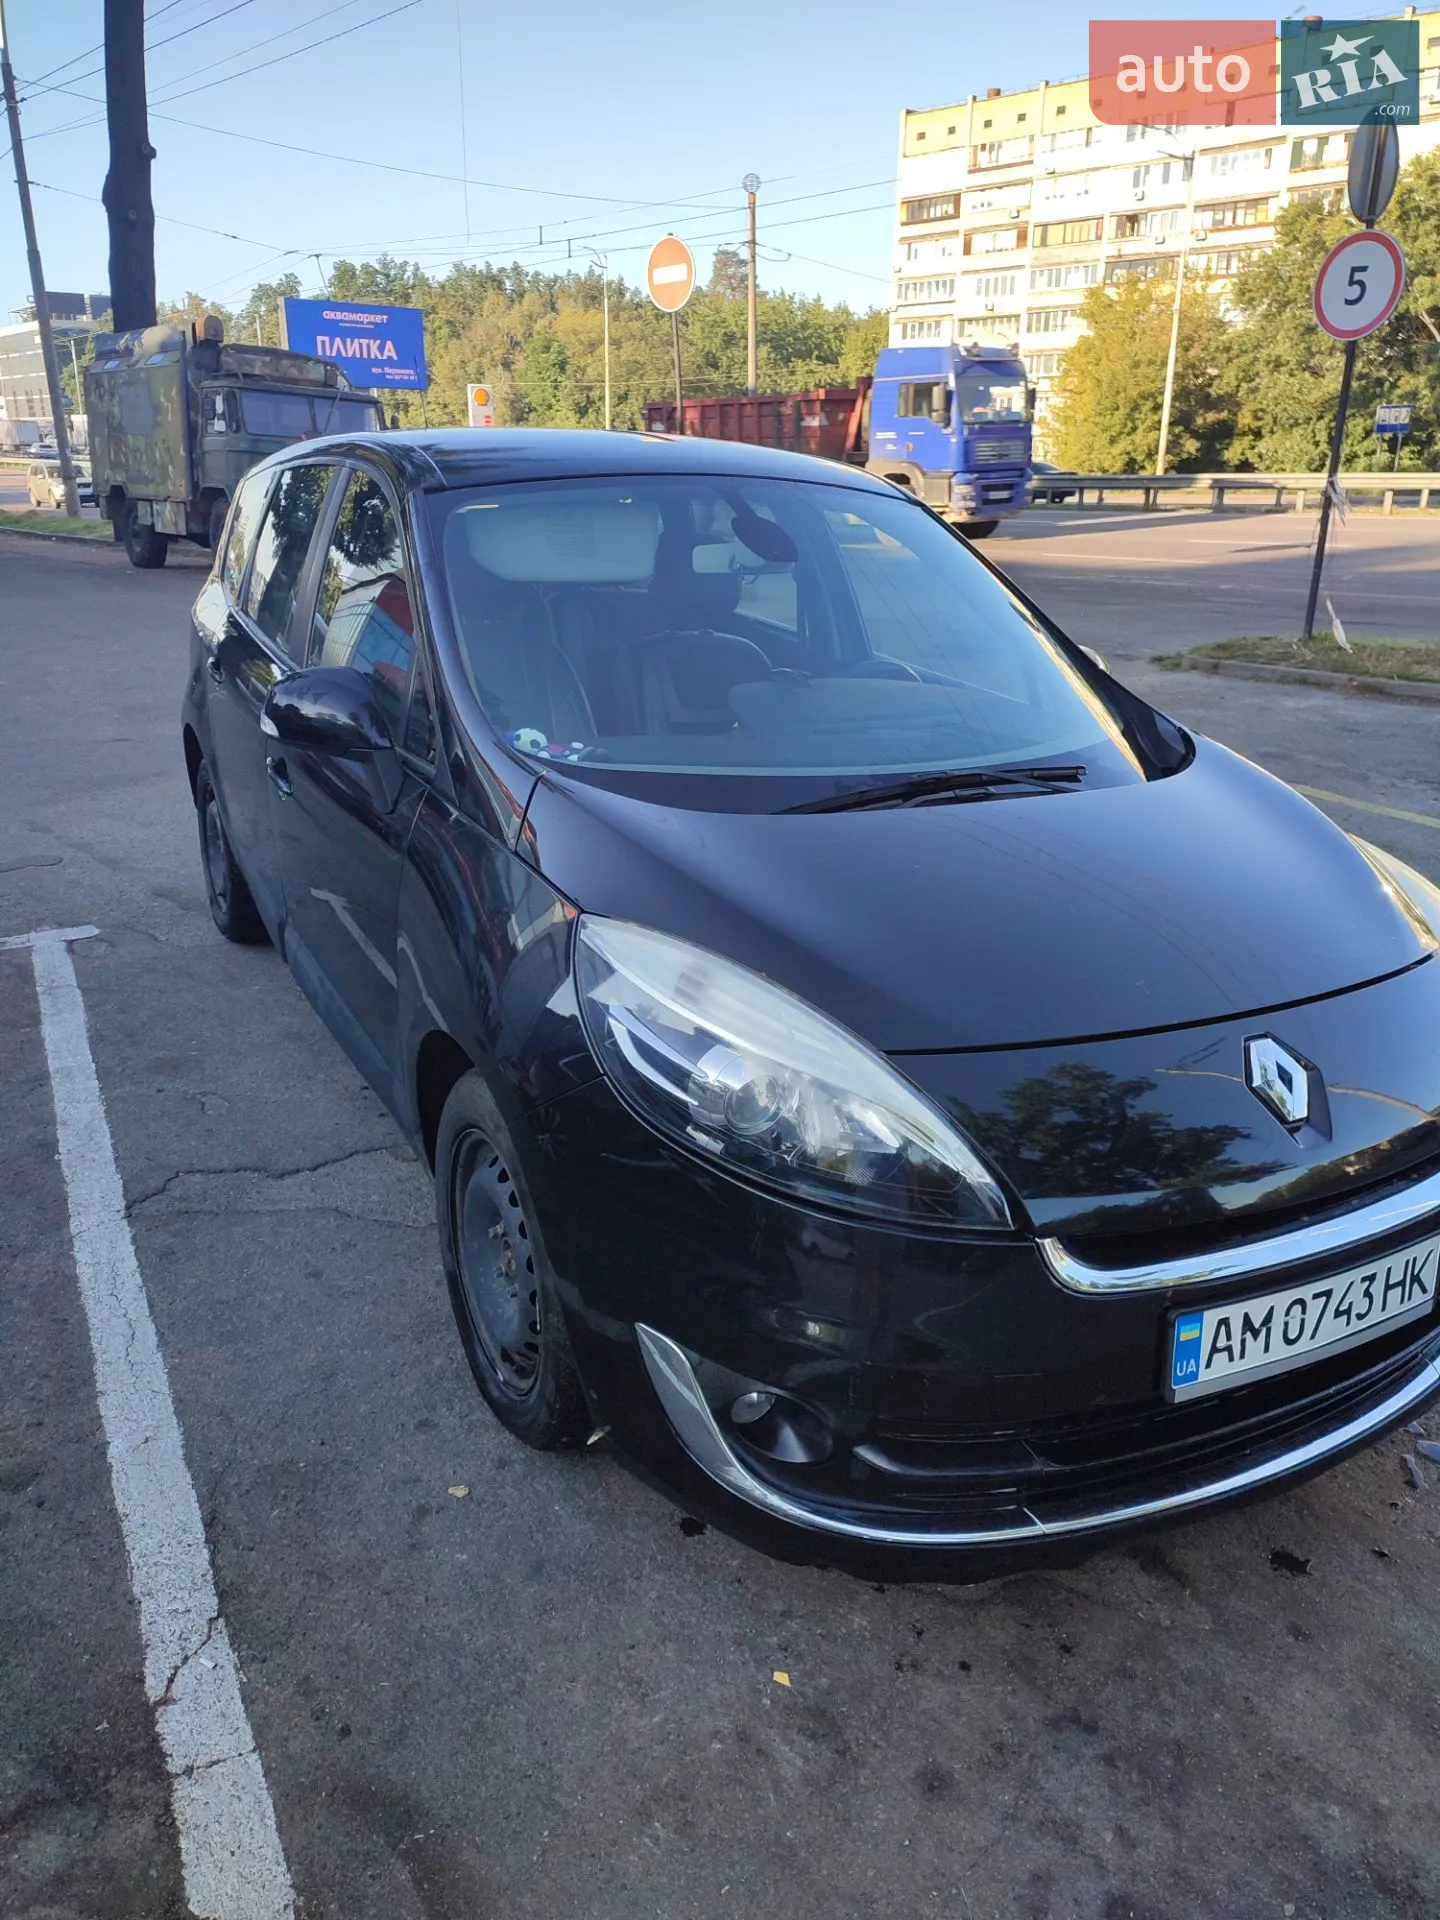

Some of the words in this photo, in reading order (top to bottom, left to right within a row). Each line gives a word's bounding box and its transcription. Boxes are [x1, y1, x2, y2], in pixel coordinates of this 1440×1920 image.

[1344, 265, 1369, 306] 5
[323, 310, 389, 324] аквамаркет
[316, 335, 398, 361] ПЛИТКА
[1176, 1359, 1197, 1377] UA
